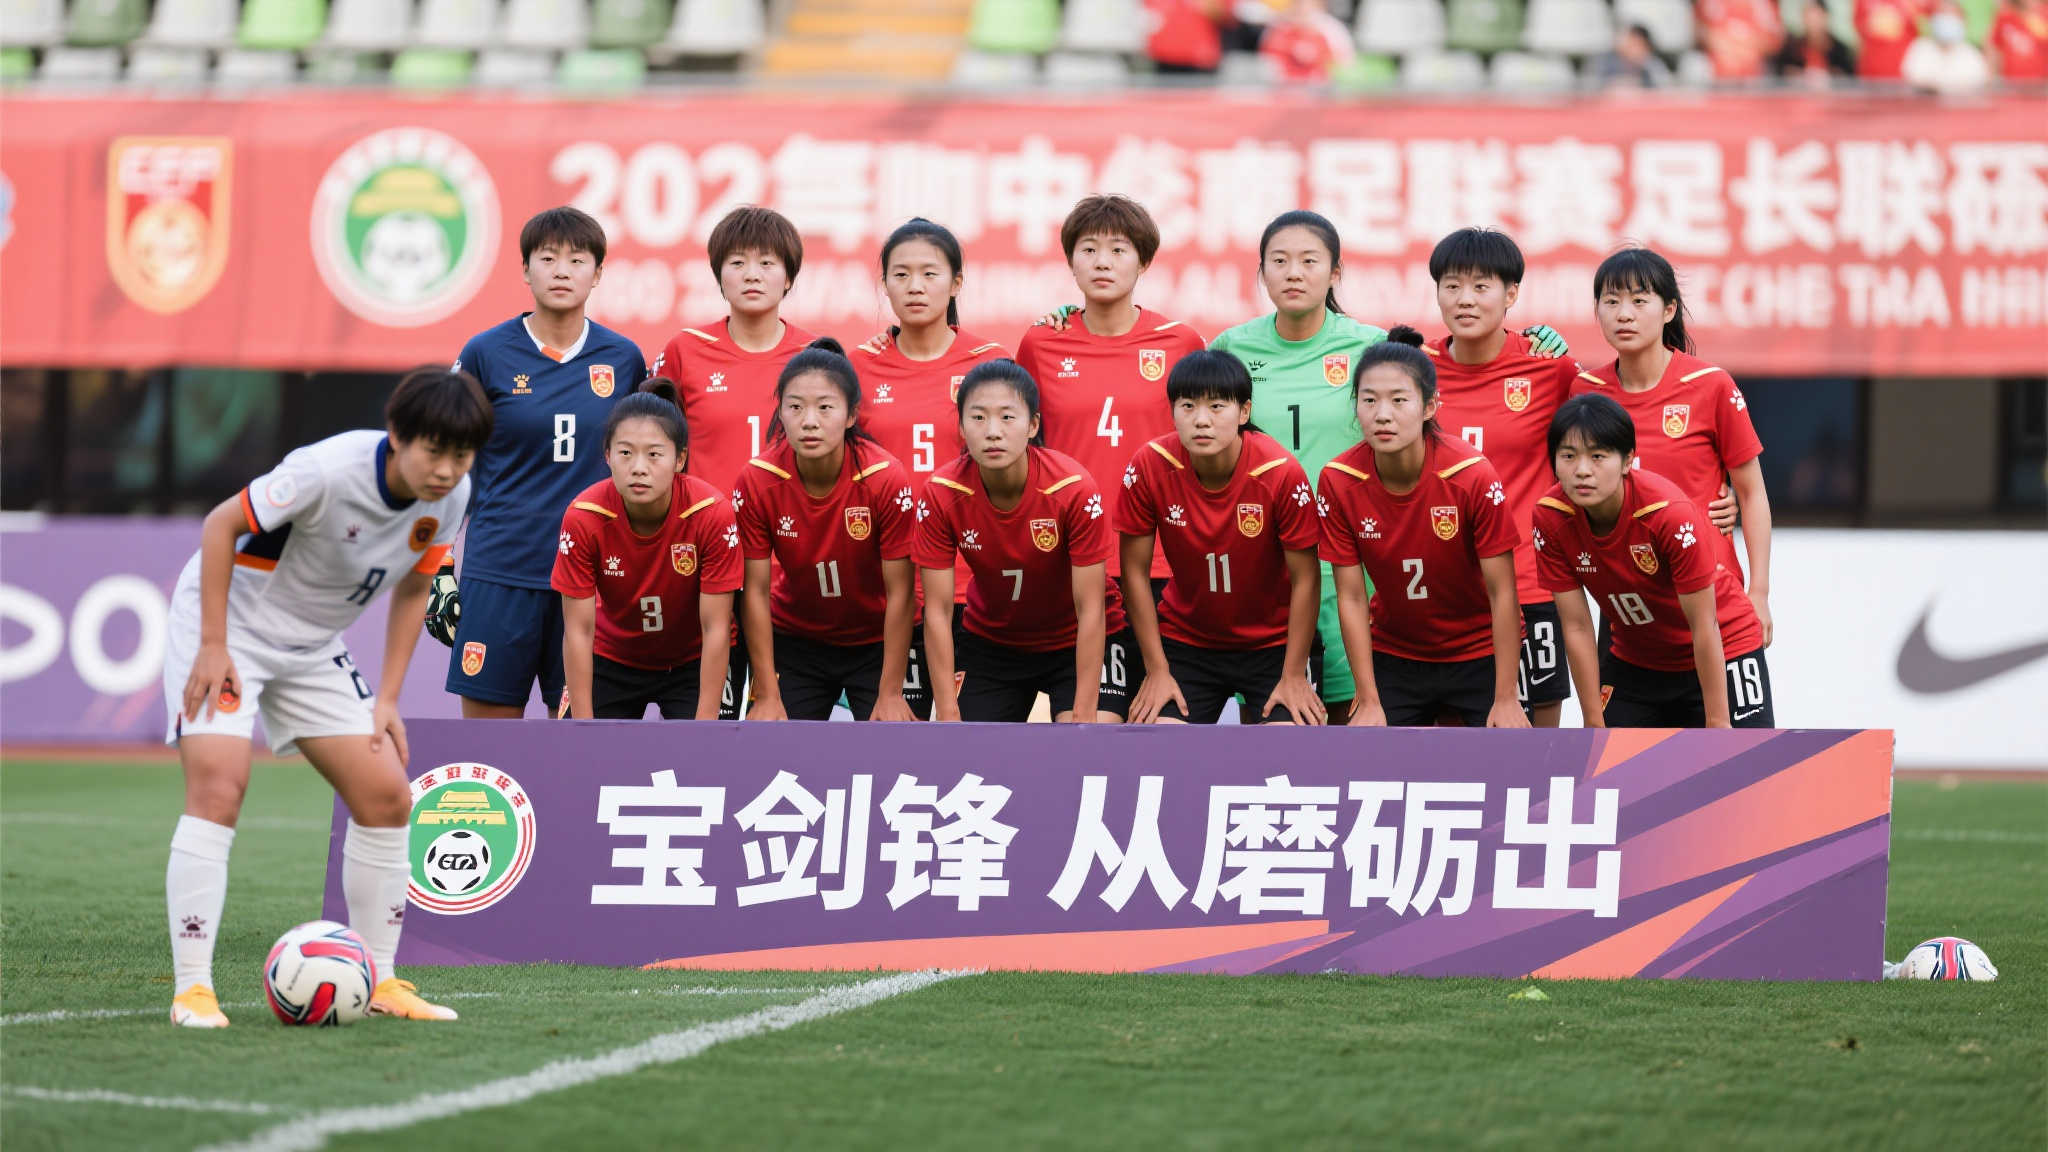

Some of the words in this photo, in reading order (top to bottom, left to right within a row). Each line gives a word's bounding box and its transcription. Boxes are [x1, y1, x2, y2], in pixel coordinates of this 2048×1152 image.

[553, 413, 576, 462] 8
[1097, 396, 1123, 447] 4
[1287, 404, 1300, 450] 1
[913, 424, 935, 472] 5
[1002, 569, 1024, 601] 7
[1205, 553, 1232, 593] 11
[1402, 558, 1428, 600] 2
[640, 596, 664, 633] 3
[592, 770, 1018, 910] 宝剑锋
[1048, 775, 1621, 917] 从磨砺出
